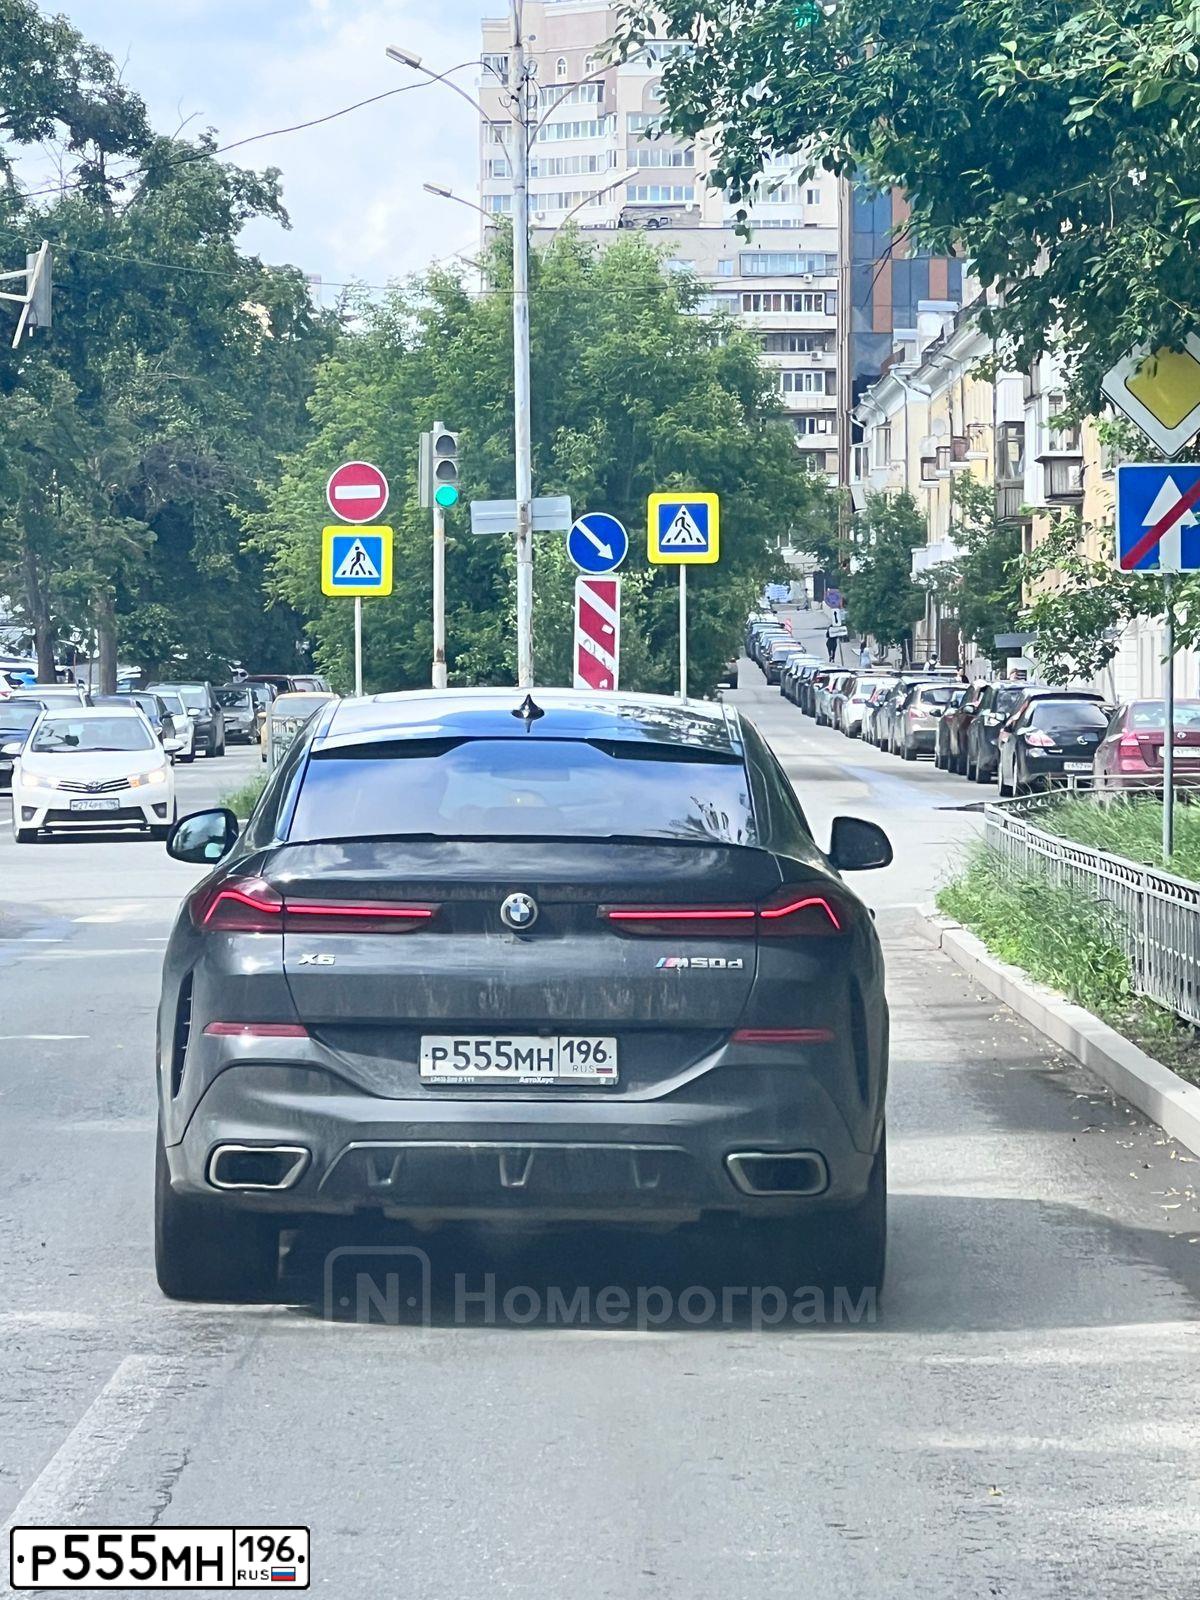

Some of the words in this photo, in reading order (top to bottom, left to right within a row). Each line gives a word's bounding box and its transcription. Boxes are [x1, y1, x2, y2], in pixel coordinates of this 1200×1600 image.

[298, 954, 335, 966] X6
[657, 957, 743, 969] M50d
[431, 1040, 554, 1071] Р555МН
[562, 1040, 607, 1063] 196
[572, 1064, 595, 1073] RUS
